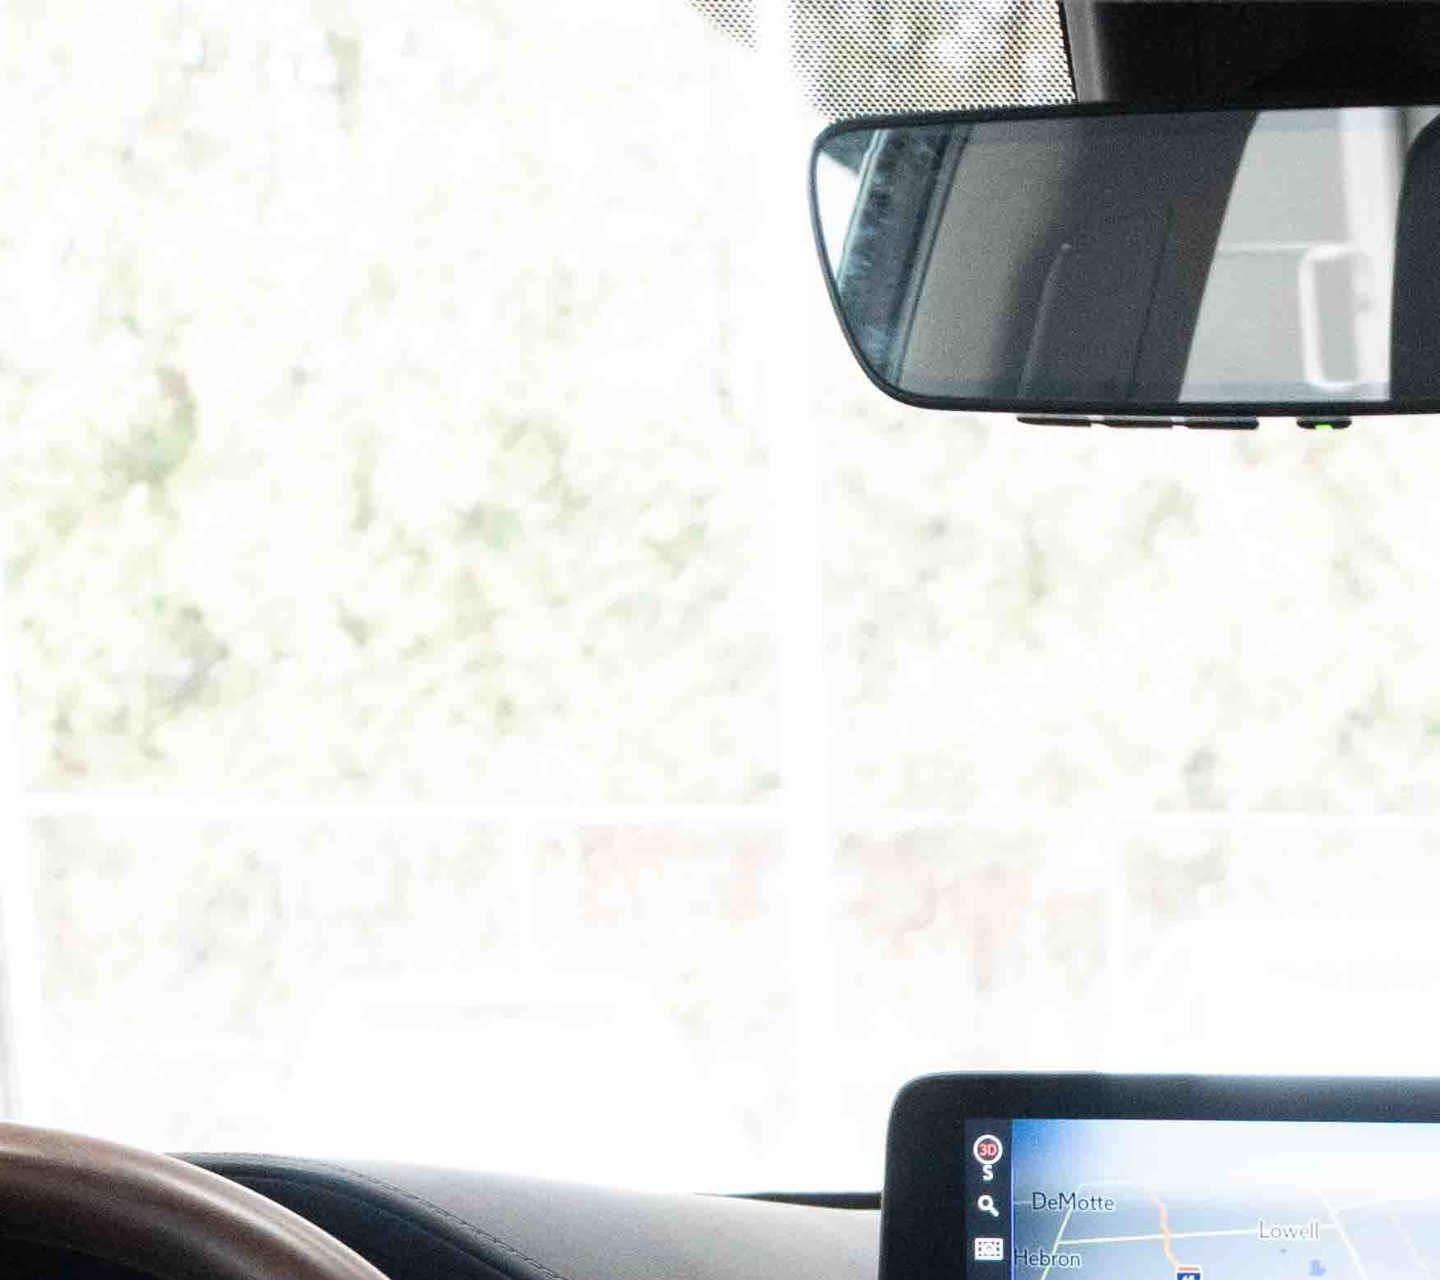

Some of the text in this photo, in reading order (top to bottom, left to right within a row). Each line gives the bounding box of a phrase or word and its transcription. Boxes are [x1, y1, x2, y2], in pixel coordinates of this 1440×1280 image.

[979, 1143, 997, 1158] 3D
[1031, 1192, 1115, 1212] DeMotte
[1258, 1220, 1320, 1240] Lowell
[1014, 1249, 1081, 1268] Hebron
